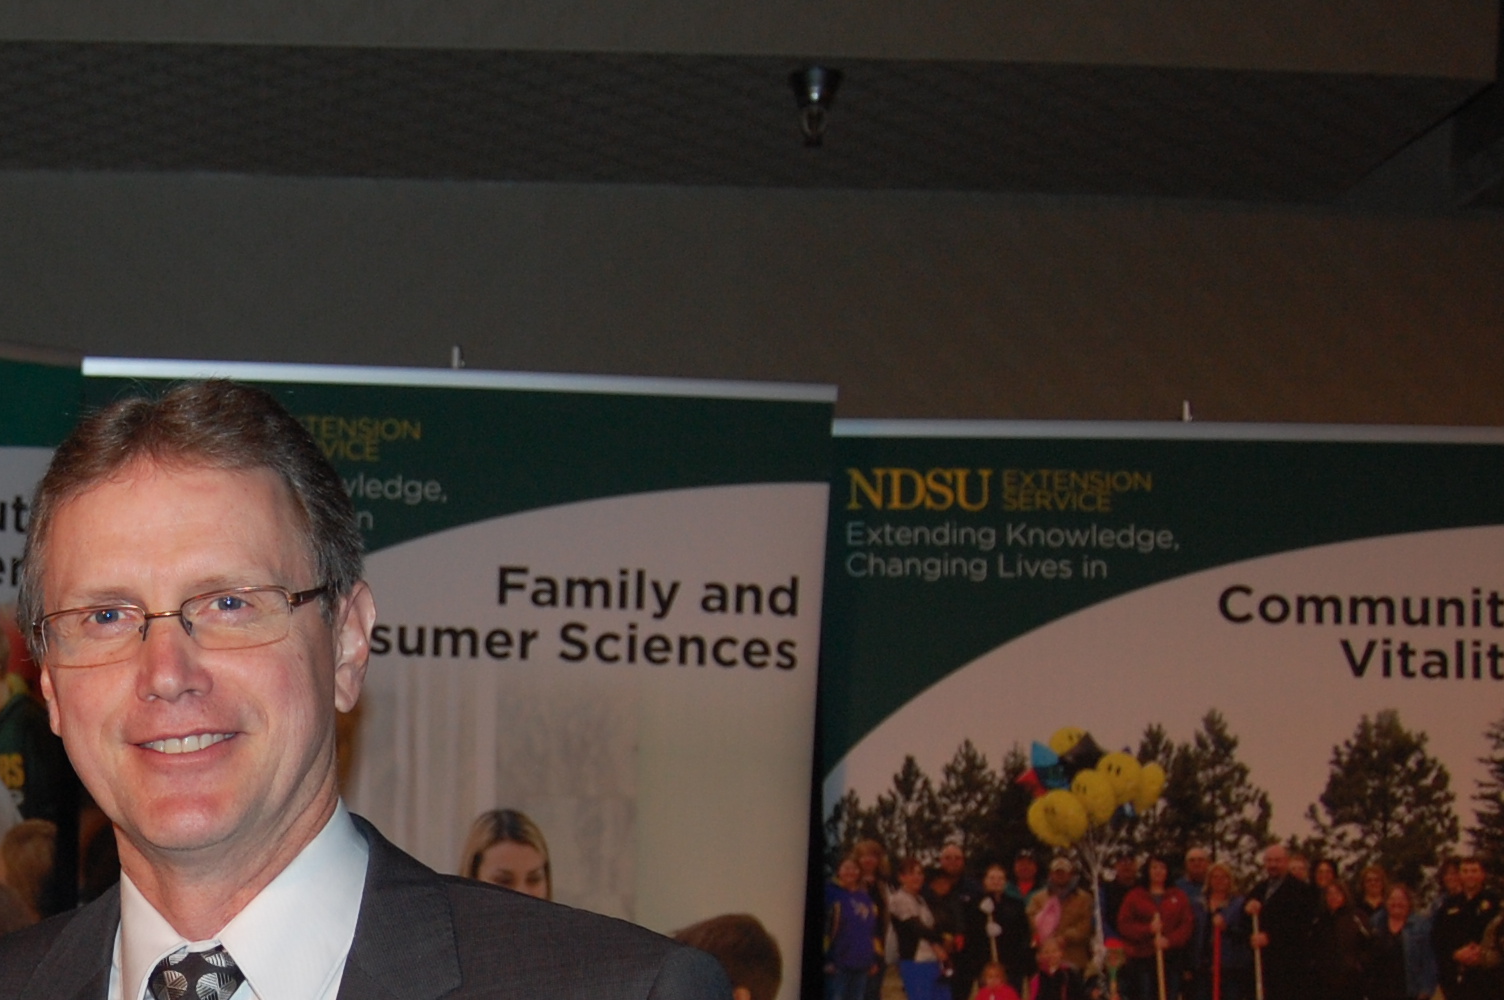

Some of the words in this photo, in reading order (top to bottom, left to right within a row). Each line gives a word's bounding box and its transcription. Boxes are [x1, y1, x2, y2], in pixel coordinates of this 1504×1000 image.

[302, 415, 422, 441] TENSION
[318, 438, 380, 462] VICE
[846, 467, 994, 512] NDSU
[1002, 469, 1153, 493] EXTENSION
[1002, 488, 1113, 513] SERVICE
[356, 510, 374, 530] n
[846, 521, 997, 550] Extending
[1006, 522, 1180, 554] Knowledge,
[846, 552, 988, 582] Changing
[998, 554, 1073, 579] Lives
[1083, 555, 1108, 580] in
[497, 566, 681, 620] Family
[701, 575, 799, 618] and
[1218, 584, 1504, 629] Communit
[369, 621, 539, 661] sumer
[558, 621, 798, 671] Sciences
[1340, 638, 1504, 681] Vitalit
